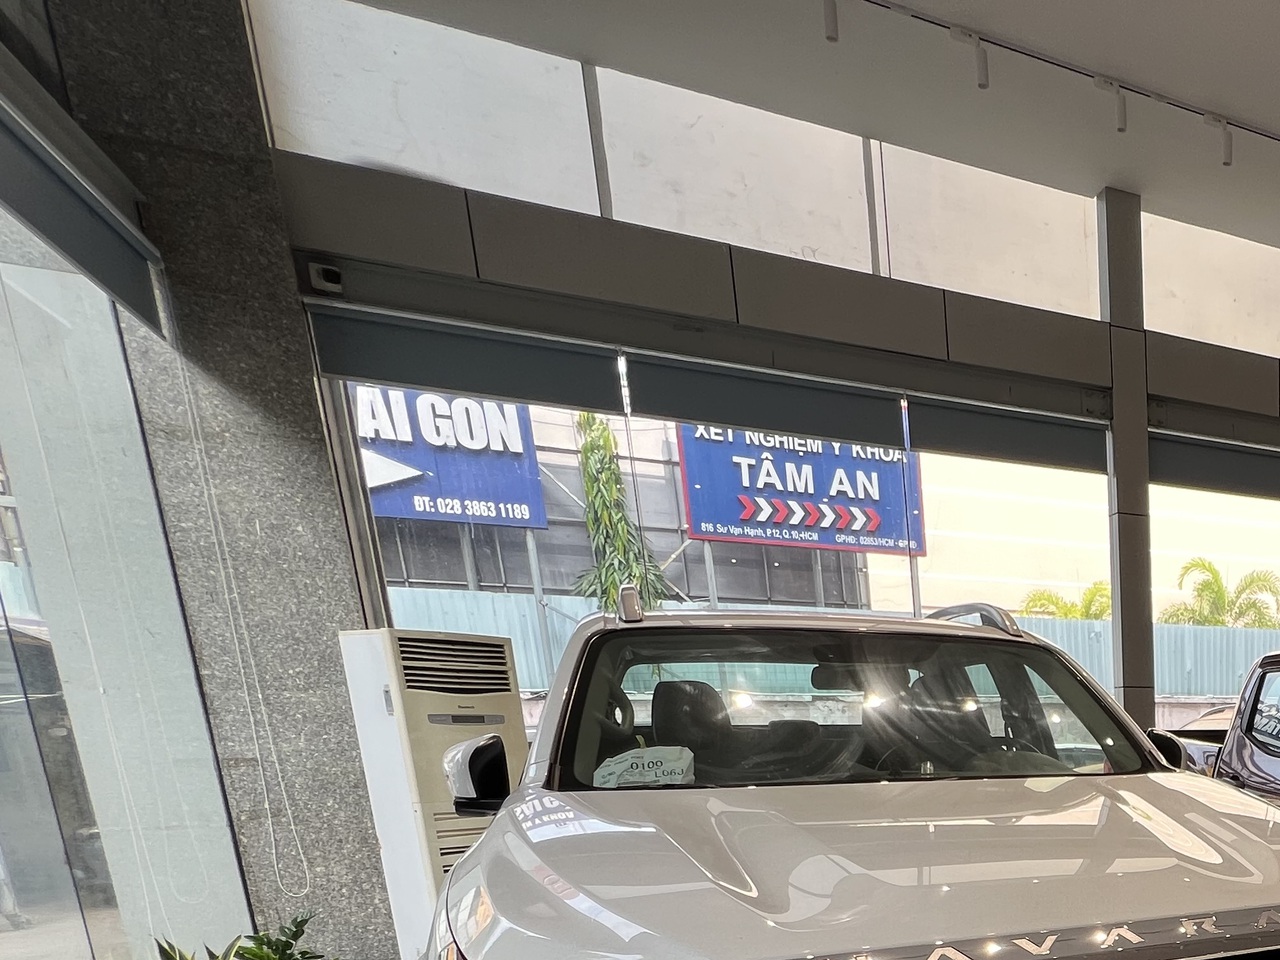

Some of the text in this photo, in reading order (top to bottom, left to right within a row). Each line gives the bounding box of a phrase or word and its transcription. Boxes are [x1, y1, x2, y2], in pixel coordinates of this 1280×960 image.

[831, 442, 841, 456] Y
[732, 452, 880, 501] TÂM AN
[414, 495, 530, 520] ĐT: 028 3863 1189
[701, 522, 714, 532] 816
